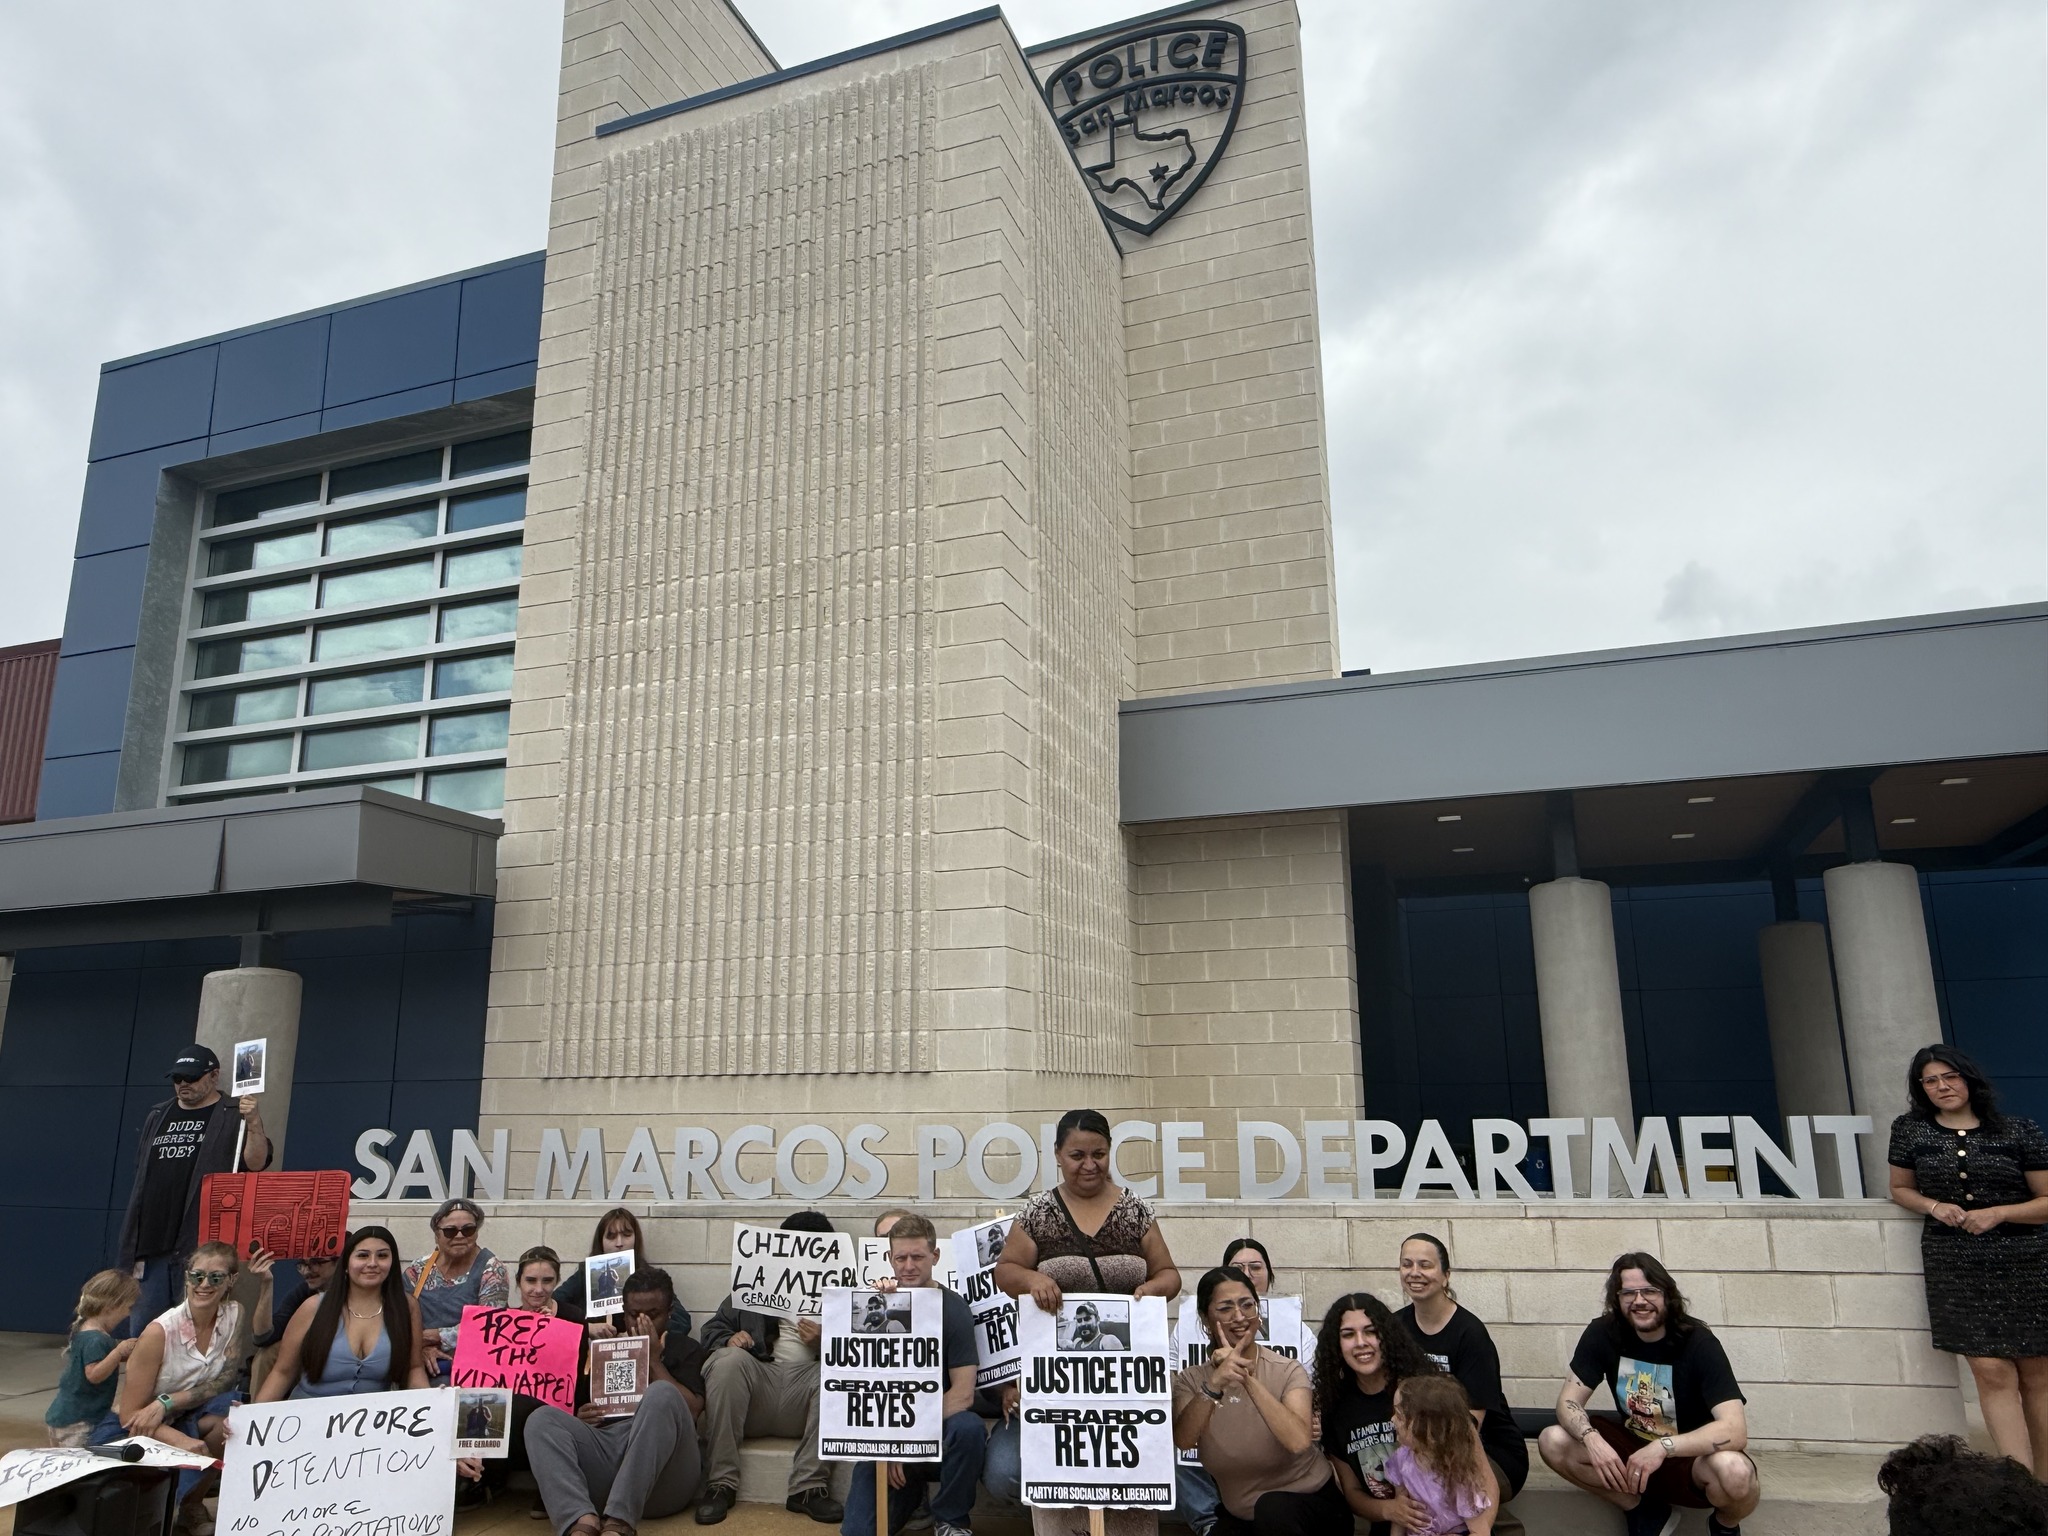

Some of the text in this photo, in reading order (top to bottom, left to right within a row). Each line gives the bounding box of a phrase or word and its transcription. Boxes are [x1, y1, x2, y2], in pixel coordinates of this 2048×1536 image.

[1060, 32, 1228, 106] POLICE
[1061, 84, 1231, 144] San Marcos
[167, 1121, 205, 1133] DUDE
[158, 1145, 196, 1160] TOE?
[350, 1116, 1873, 1200] SAN MARCOS POLCE DEPARTMENT
[738, 1229, 840, 1263] CHINGA
[732, 1266, 765, 1291] LA
[774, 1267, 858, 1298] MIGRA
[963, 1267, 1002, 1305] JUST
[742, 1292, 822, 1314] GERARDO LI
[473, 1308, 550, 1348] FREE
[986, 1311, 1020, 1354] REY
[488, 1345, 538, 1366] THE
[825, 1337, 939, 1368] JUSTICE FOR
[990, 1366, 1001, 1380] FOR
[1001, 1361, 1021, 1376] SOCIALIS
[1026, 1356, 1118, 1394] JUSTICE
[1120, 1356, 1167, 1394] FOR
[454, 1368, 575, 1408] KIDNAPPED
[824, 1379, 939, 1394] GERARDO
[847, 1392, 915, 1428] REYES
[1024, 1409, 1167, 1425] GERARDO
[246, 1406, 433, 1446] NO MORE
[1356, 1422, 1380, 1438] FAMILY
[458, 1440, 501, 1448] FREE GERARDO
[824, 1441, 938, 1455] PARTY FOR SOCIALISM & LIBERATION
[1055, 1424, 1140, 1468] REYES
[1347, 1433, 1395, 1454] ANSWERS AND
[252, 1446, 434, 1501] DETENTION
[1028, 1486, 1168, 1501] PARTY FOR SOCIALISM & LIBERATION
[231, 1500, 370, 1531] NO MORE
